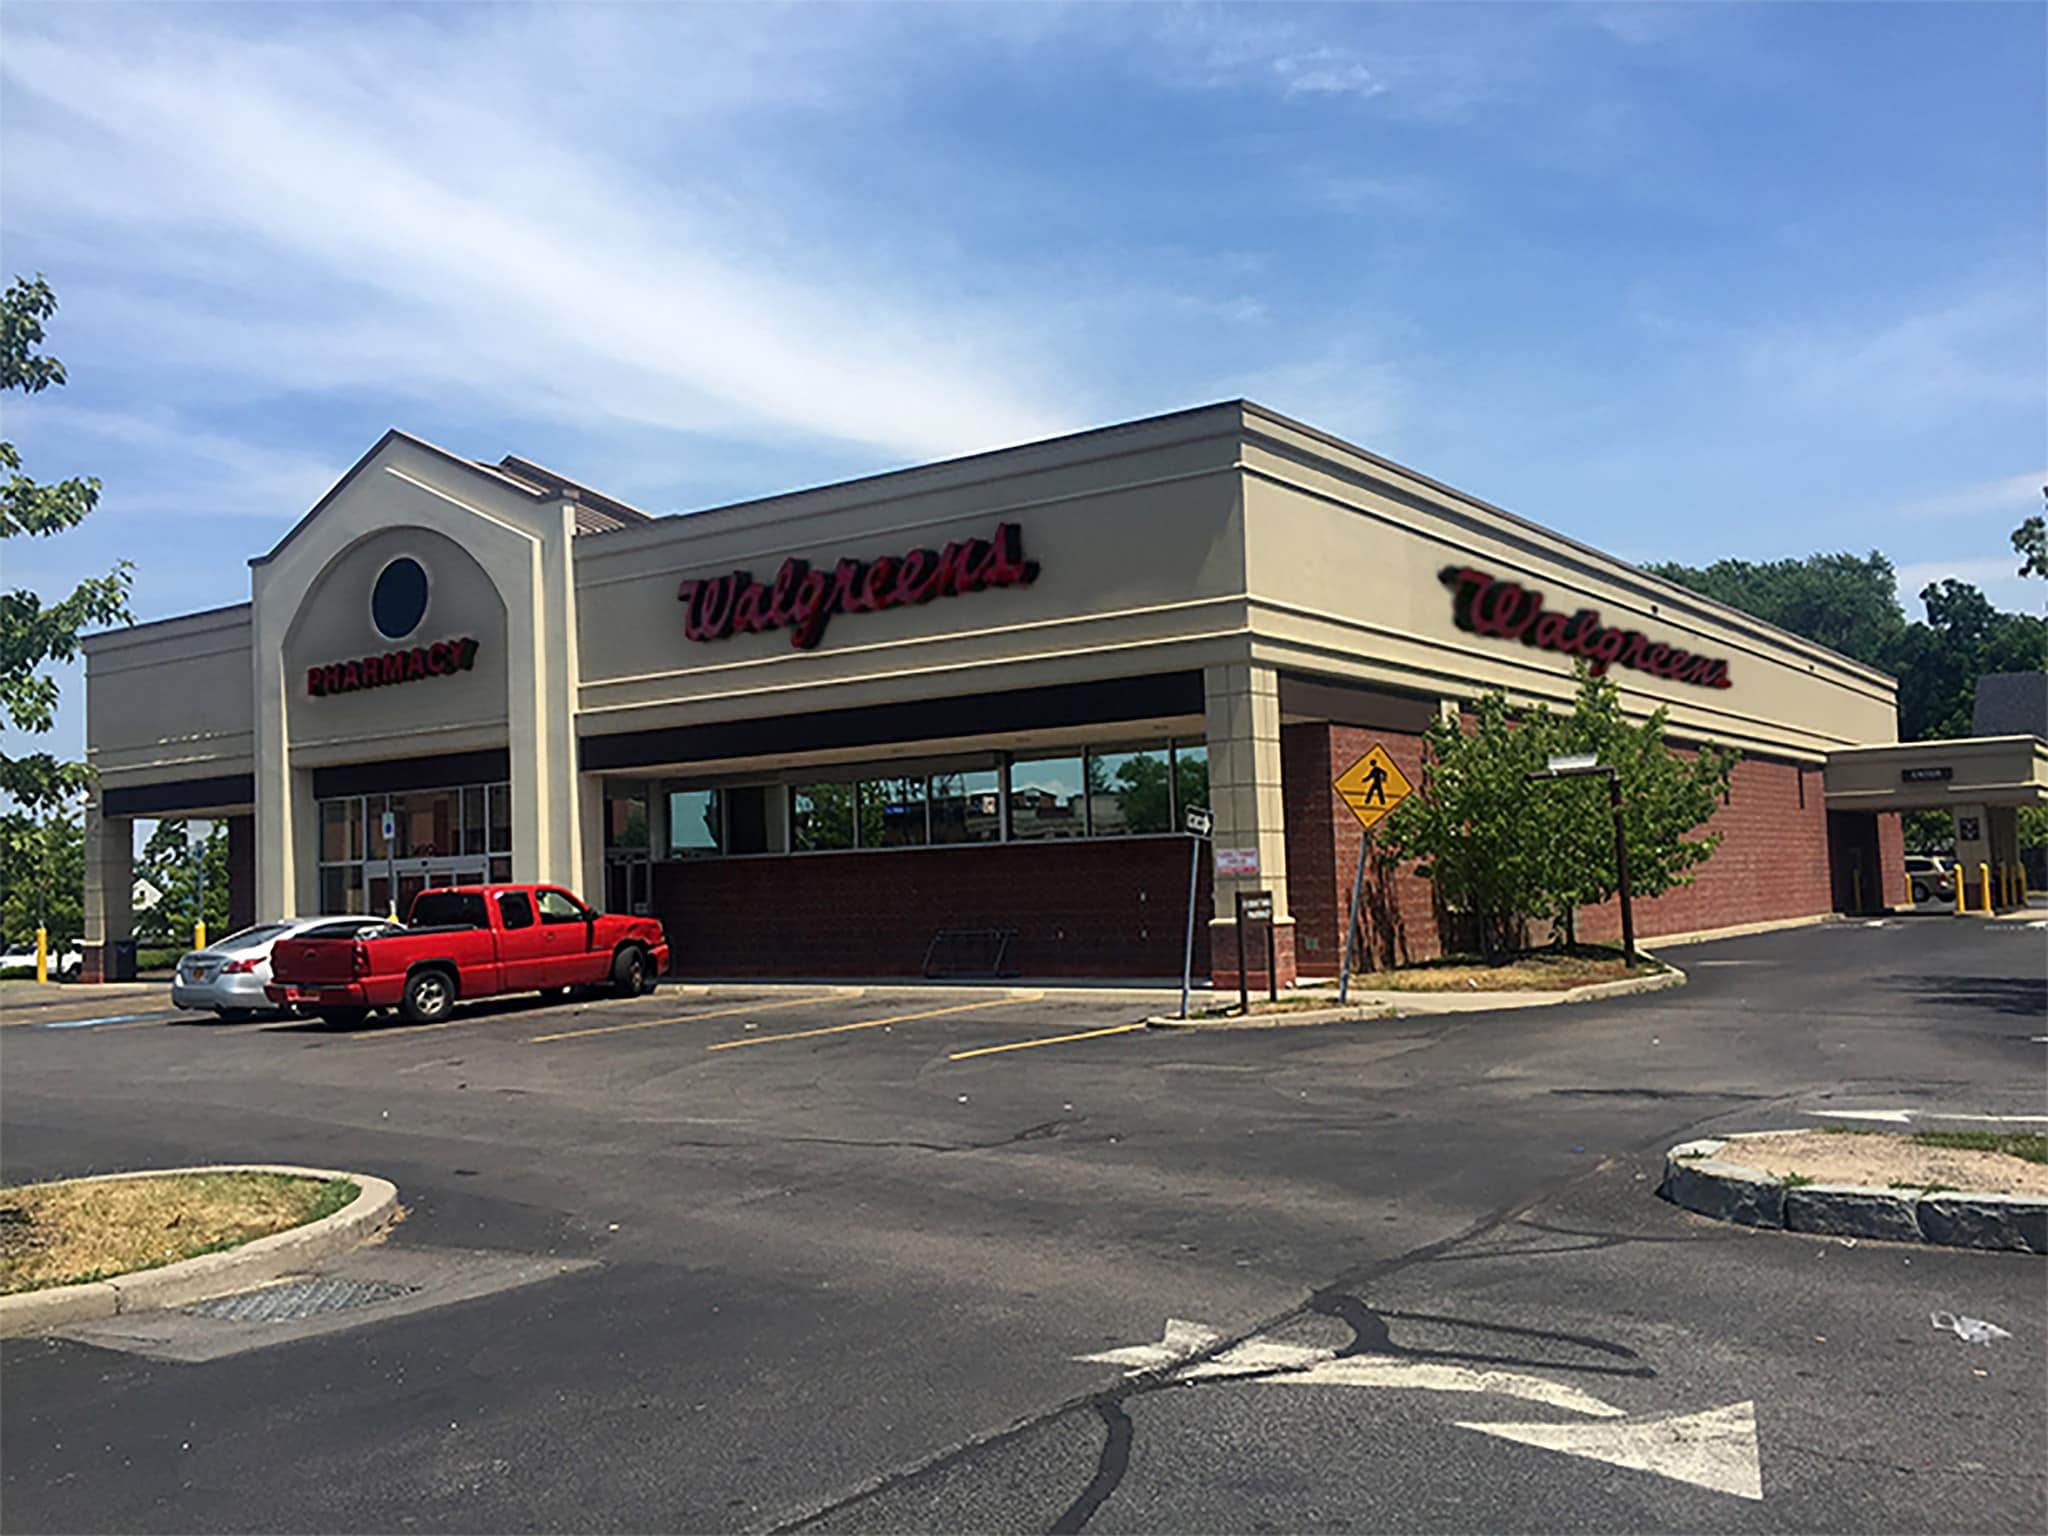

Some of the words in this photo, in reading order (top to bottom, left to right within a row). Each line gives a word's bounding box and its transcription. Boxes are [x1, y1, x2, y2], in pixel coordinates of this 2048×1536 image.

[677, 522, 1040, 648] Walgreens
[1438, 565, 1733, 689] Walgreens
[307, 637, 479, 697] PHARMACY
